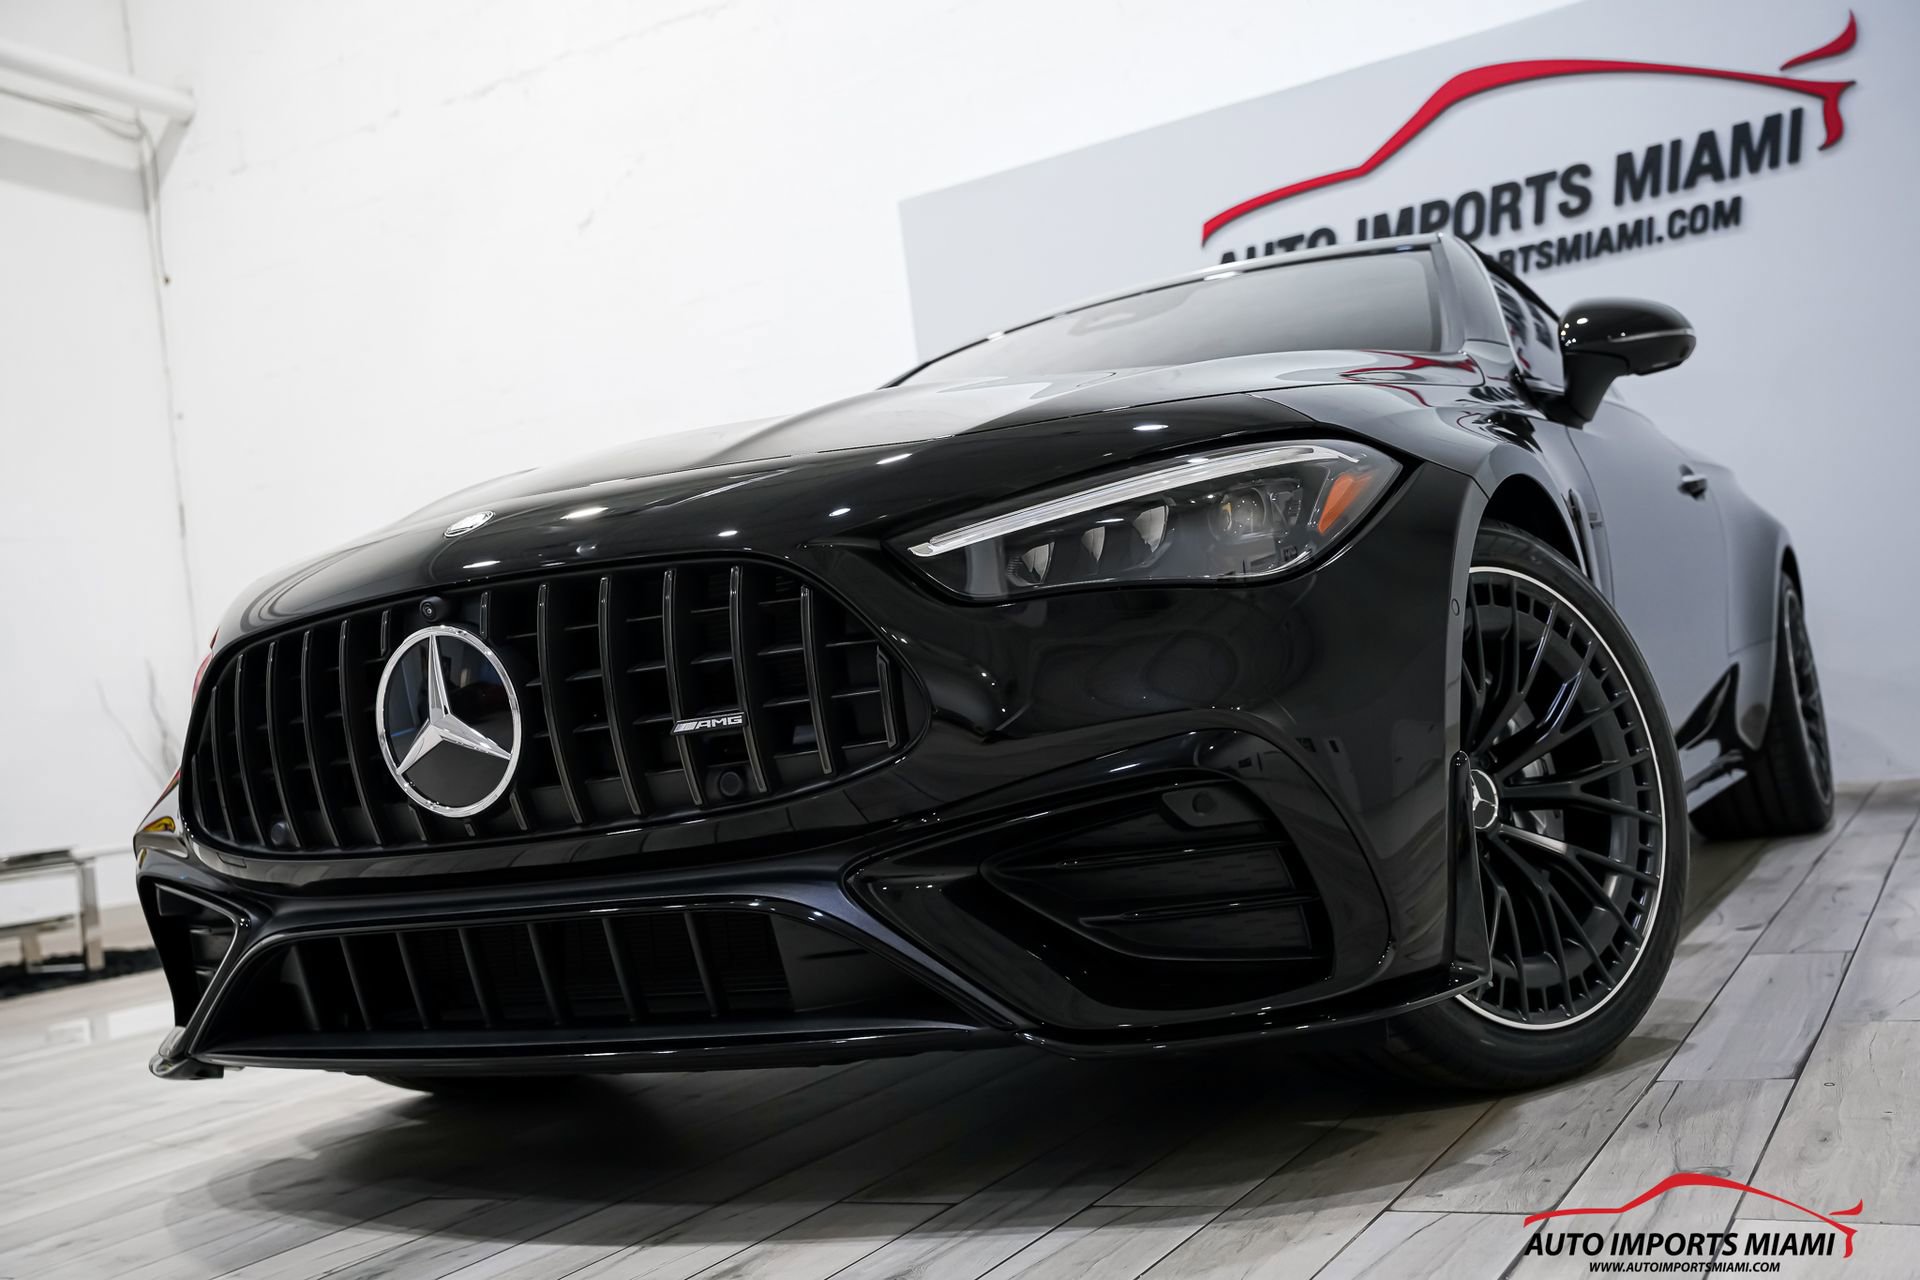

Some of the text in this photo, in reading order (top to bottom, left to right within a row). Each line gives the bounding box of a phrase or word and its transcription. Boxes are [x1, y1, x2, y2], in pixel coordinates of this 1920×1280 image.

[1613, 107, 1804, 207] MIAMI
[1487, 196, 1742, 275] RTSMIAMI.COM
[695, 715, 743, 730] AMG
